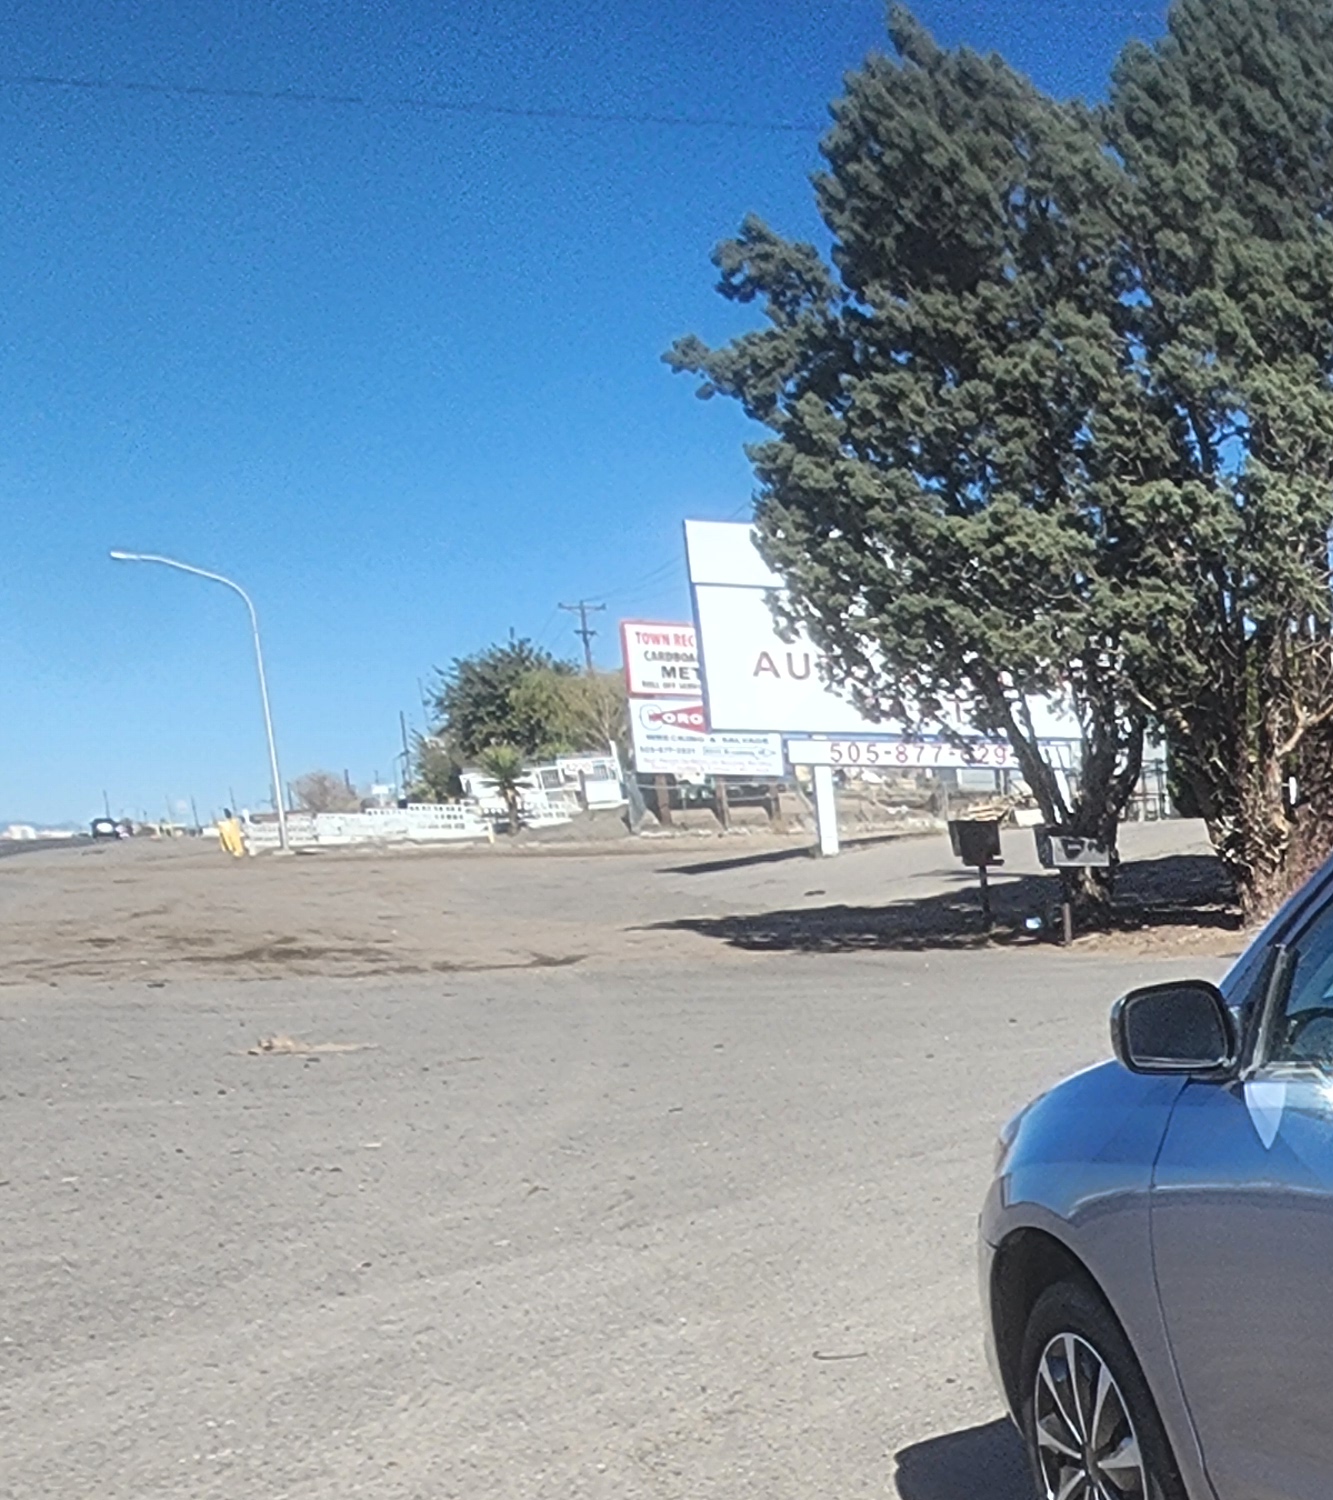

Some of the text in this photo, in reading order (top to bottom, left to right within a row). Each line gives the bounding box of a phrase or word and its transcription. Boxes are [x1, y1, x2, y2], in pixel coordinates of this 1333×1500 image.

[635, 631, 694, 648] TOWN REC
[643, 650, 697, 663] CARDBOA
[752, 650, 812, 681] AU
[661, 665, 700, 681] MET
[639, 703, 704, 732] CORO
[829, 742, 1009, 765] 505-877-29
